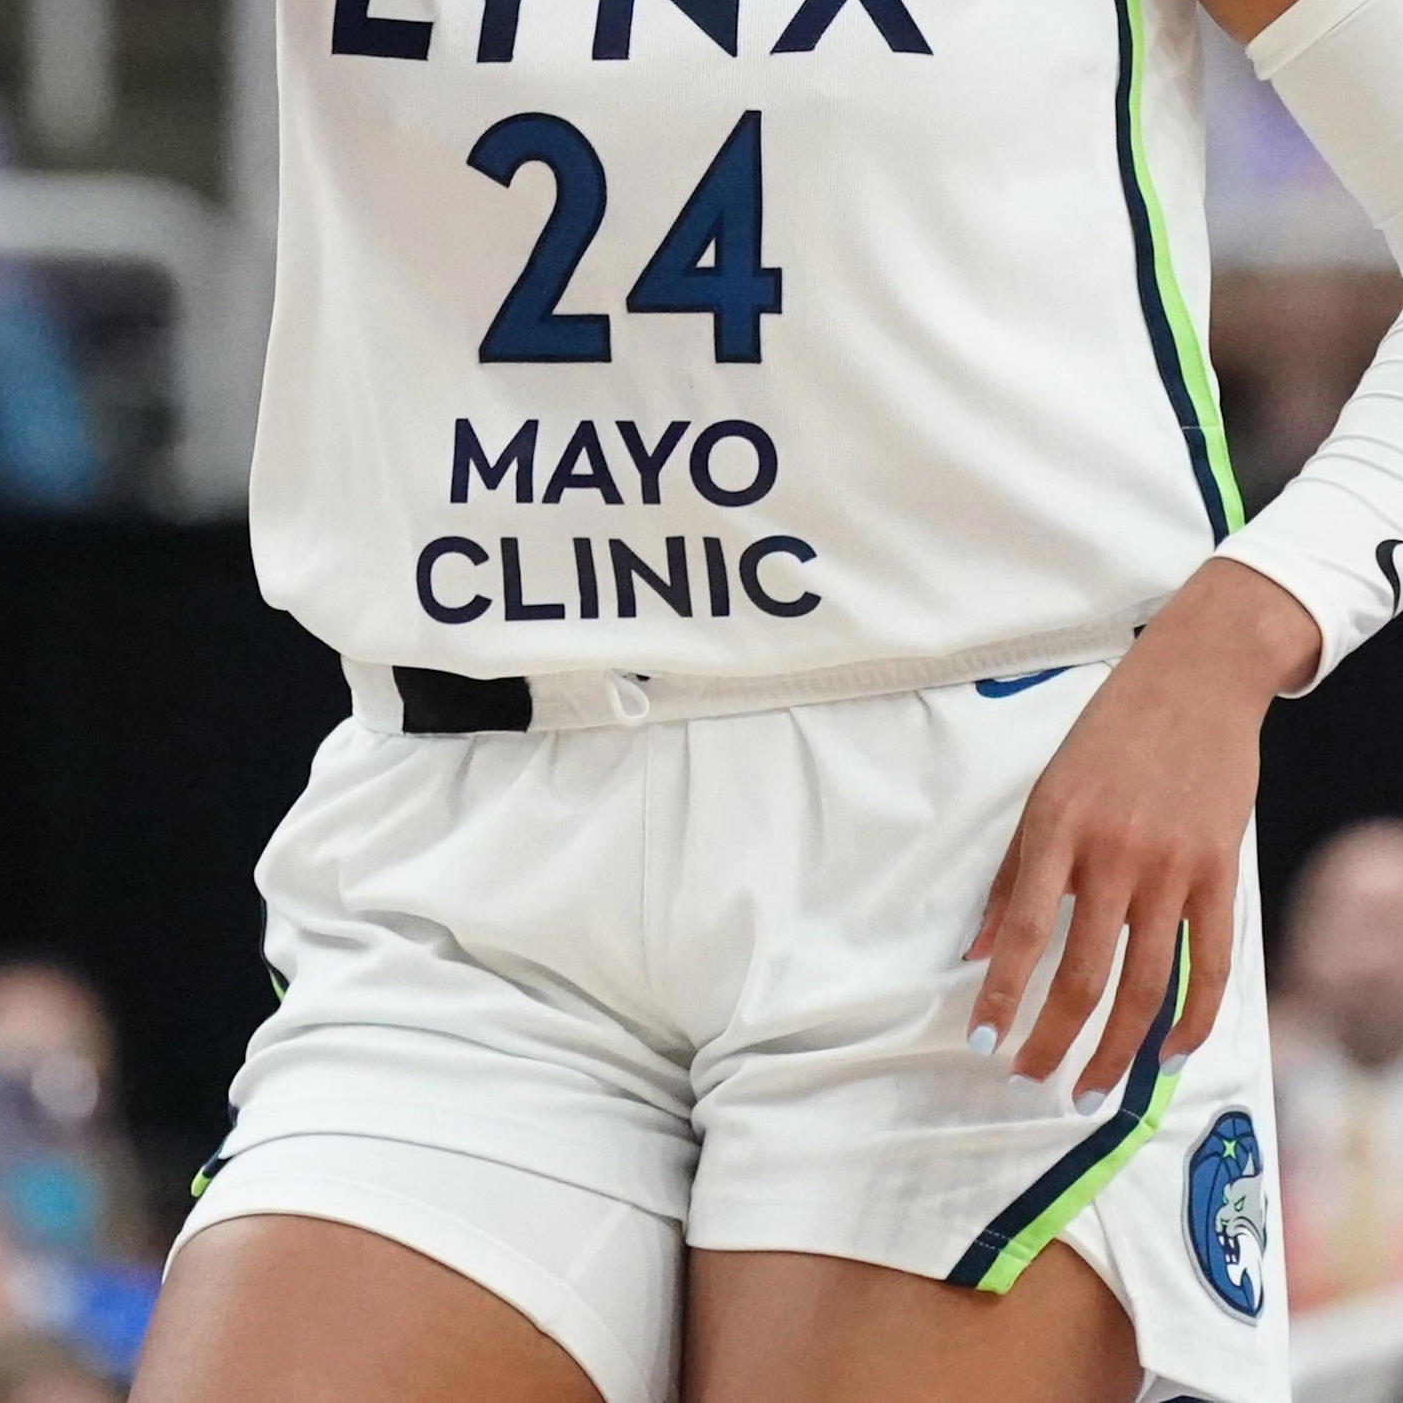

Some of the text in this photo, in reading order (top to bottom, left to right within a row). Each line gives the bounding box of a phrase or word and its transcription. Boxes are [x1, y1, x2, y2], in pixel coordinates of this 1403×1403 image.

[467, 110, 782, 364] 24
[451, 419, 777, 507] MAYO
[417, 536, 821, 624] CLINIC
